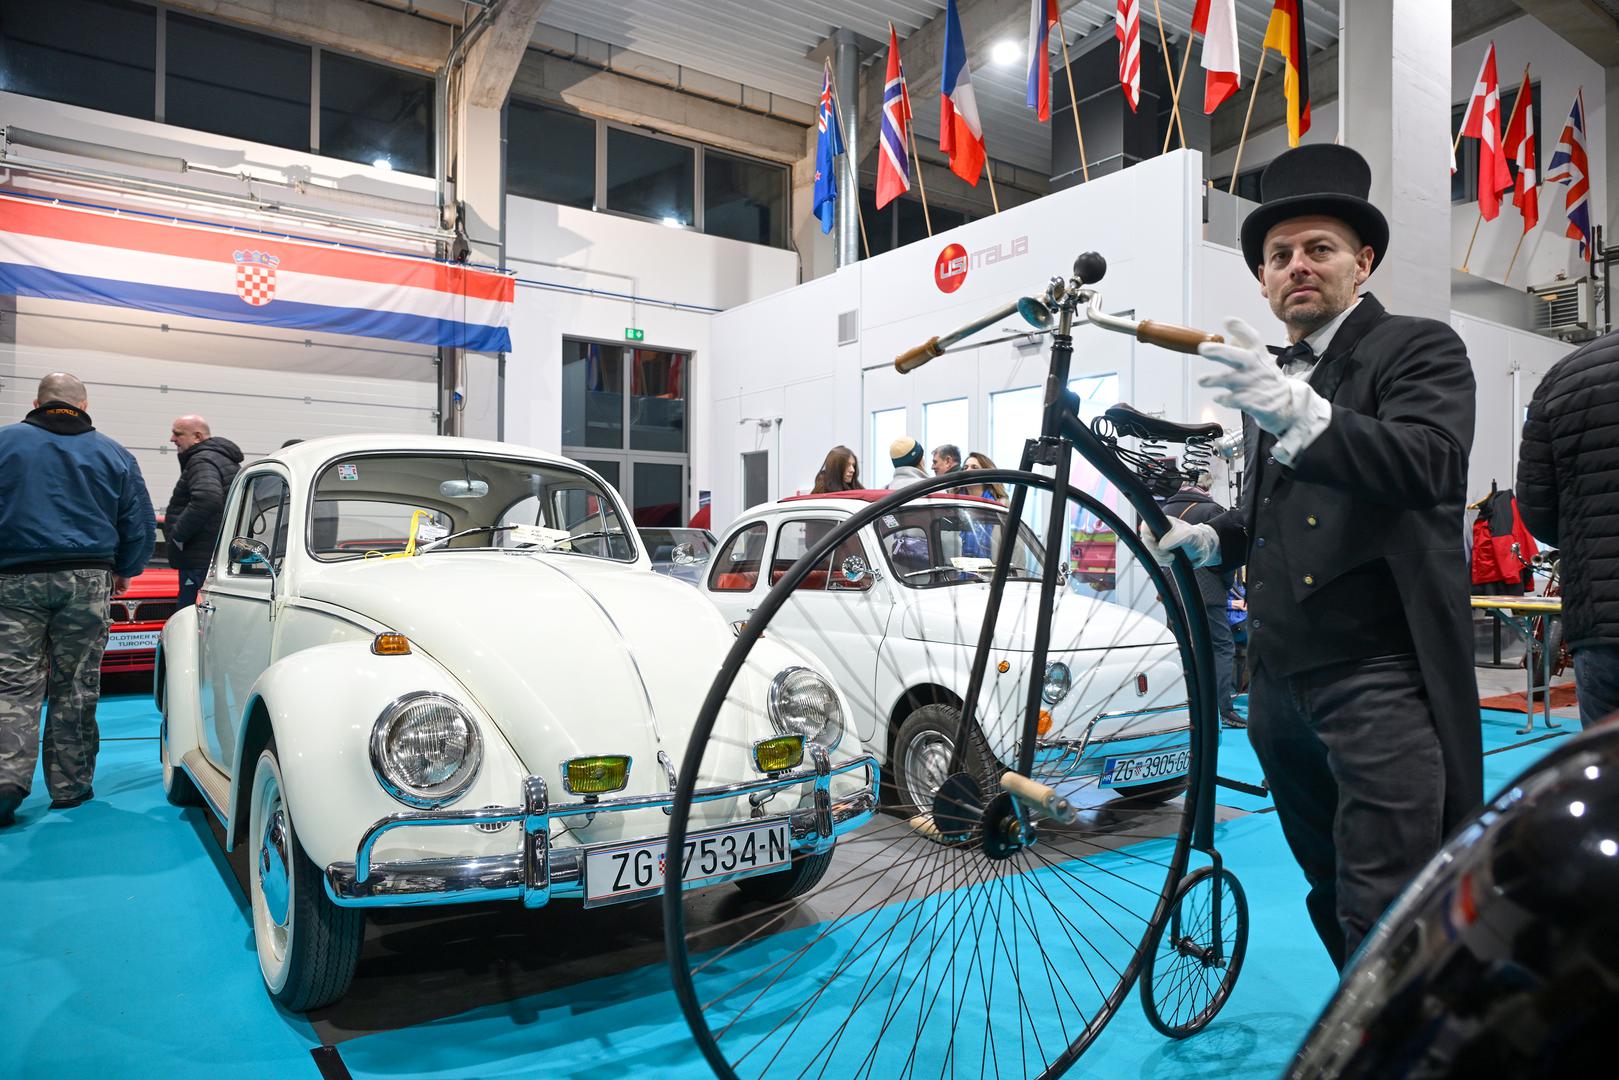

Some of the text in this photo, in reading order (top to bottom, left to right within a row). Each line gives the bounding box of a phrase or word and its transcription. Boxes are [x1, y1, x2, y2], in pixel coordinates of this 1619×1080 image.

[940, 255, 967, 280] USI
[1113, 759, 1135, 782] ZG
[612, 827, 786, 892] ZG 7534-N
